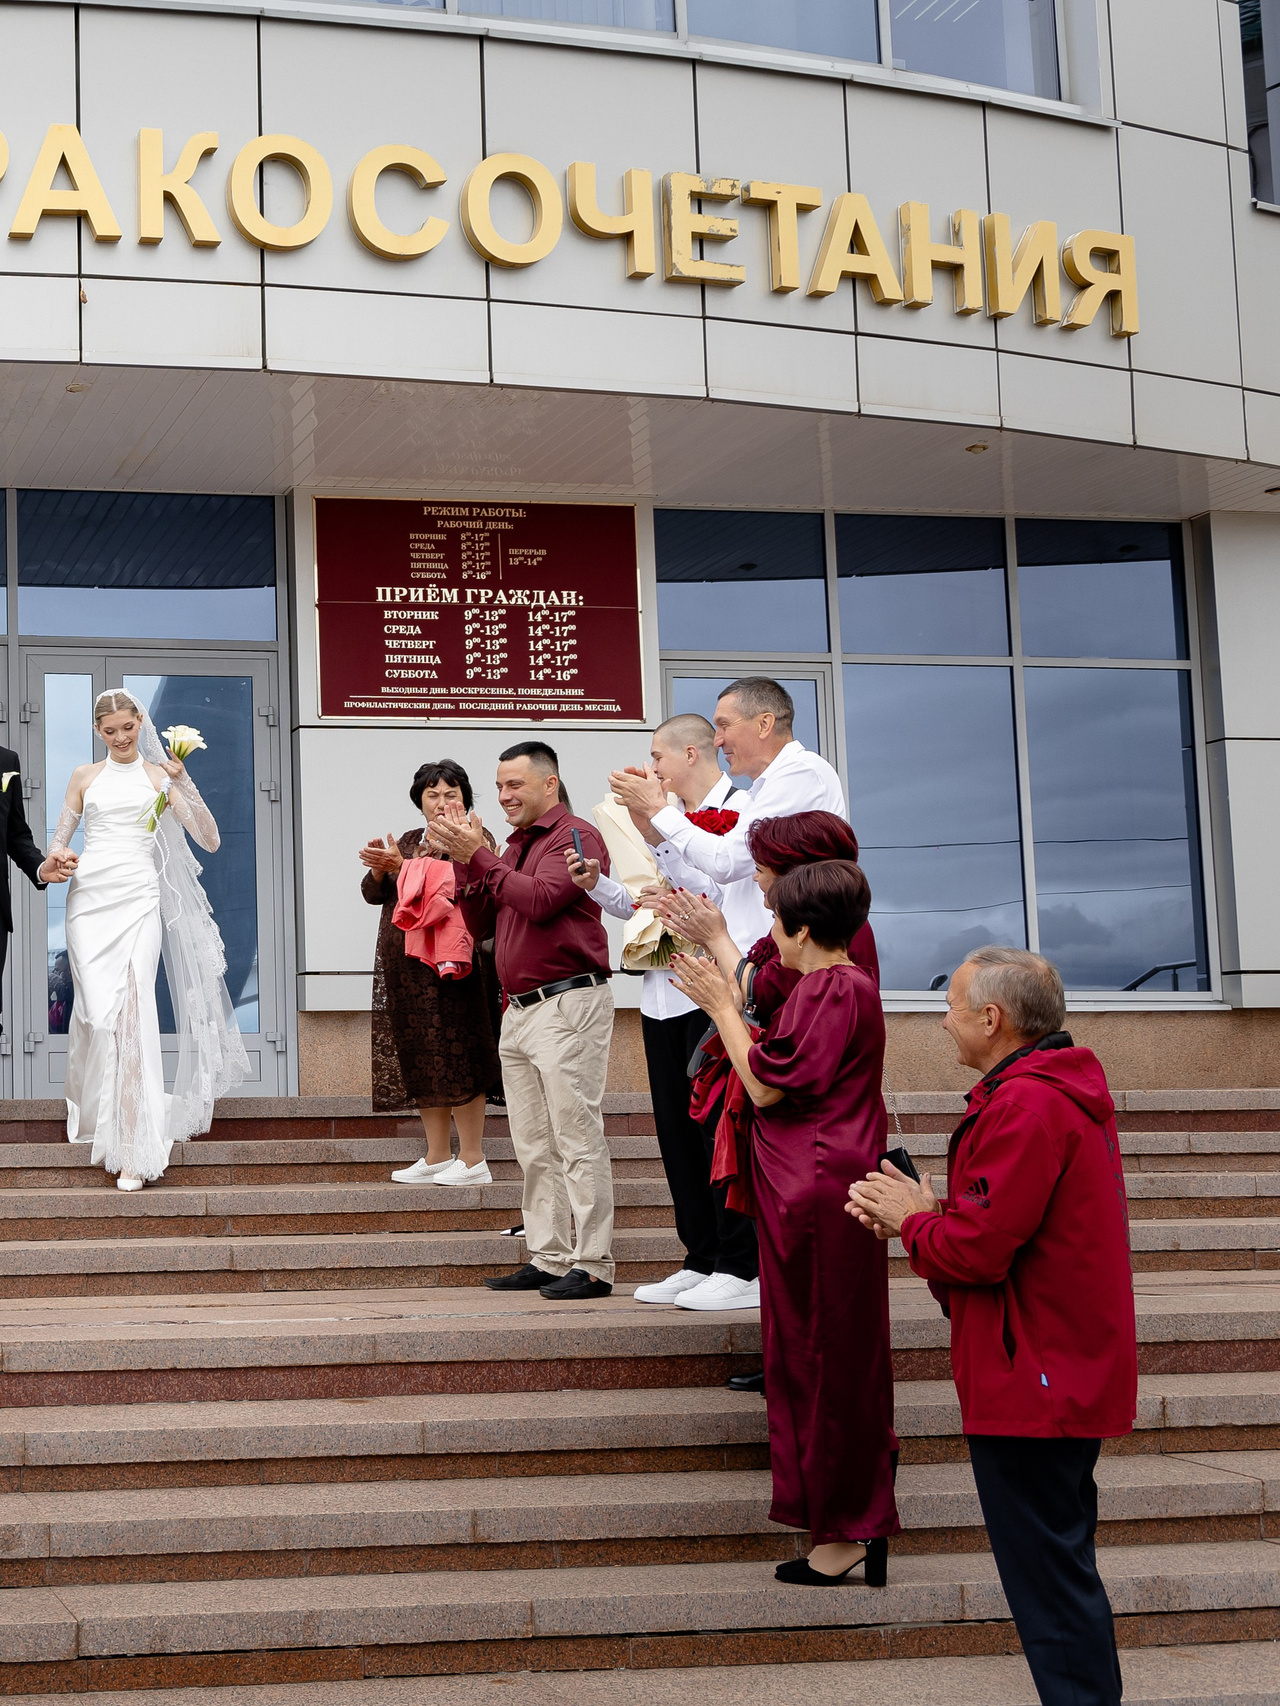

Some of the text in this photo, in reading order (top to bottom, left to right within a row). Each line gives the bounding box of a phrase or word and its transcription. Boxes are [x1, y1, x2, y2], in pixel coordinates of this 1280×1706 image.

[424, 507, 526, 517] РЕЖИМ РАБОТЫ:
[438, 520, 513, 530] РАБОЧИЙ ДЕНЬ:
[376, 584, 583, 609] ПРИЁМ ГРАЖДАН:
[384, 610, 439, 619] ВТОРНИК
[384, 625, 422, 635] СРЕДА
[385, 640, 436, 648] ЧЕТВЕРГ
[385, 655, 441, 665] ПЯТНИЦА
[385, 669, 438, 678] СУББОТА
[450, 687, 516, 695] ВОСКРЕСЕНЬЕ,
[518, 688, 584, 696] ПОНЕДЕЛЬНИК
[459, 702, 514, 710] ПОСЛЕДНИЙ
[559, 704, 583, 712] ДЕНЬ
[585, 704, 621, 712] МЕСЯЦА
